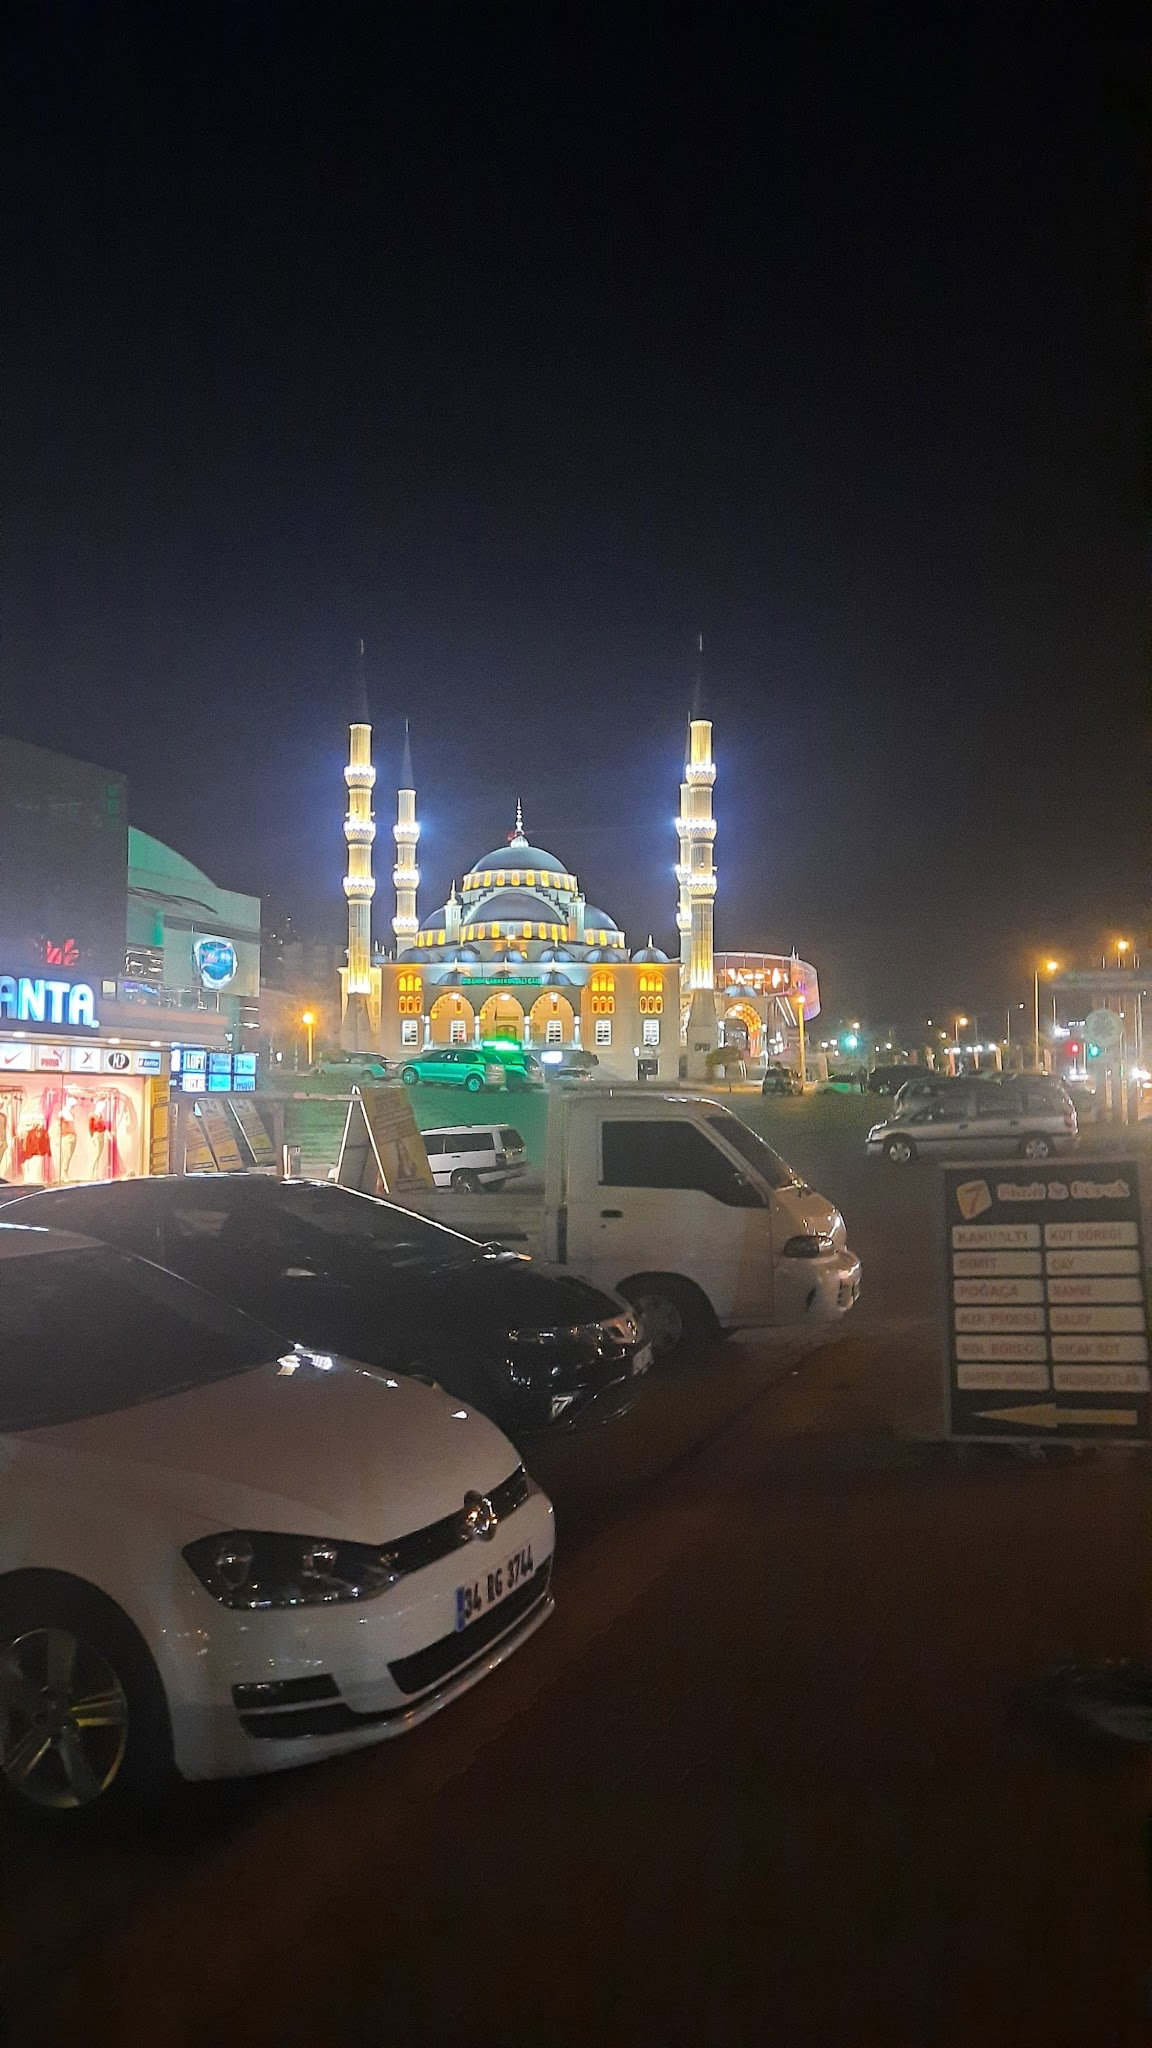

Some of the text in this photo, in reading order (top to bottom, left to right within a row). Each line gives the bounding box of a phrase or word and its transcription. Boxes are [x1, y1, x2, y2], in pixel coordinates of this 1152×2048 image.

[464, 1544, 534, 1618] 34 RG 3744
